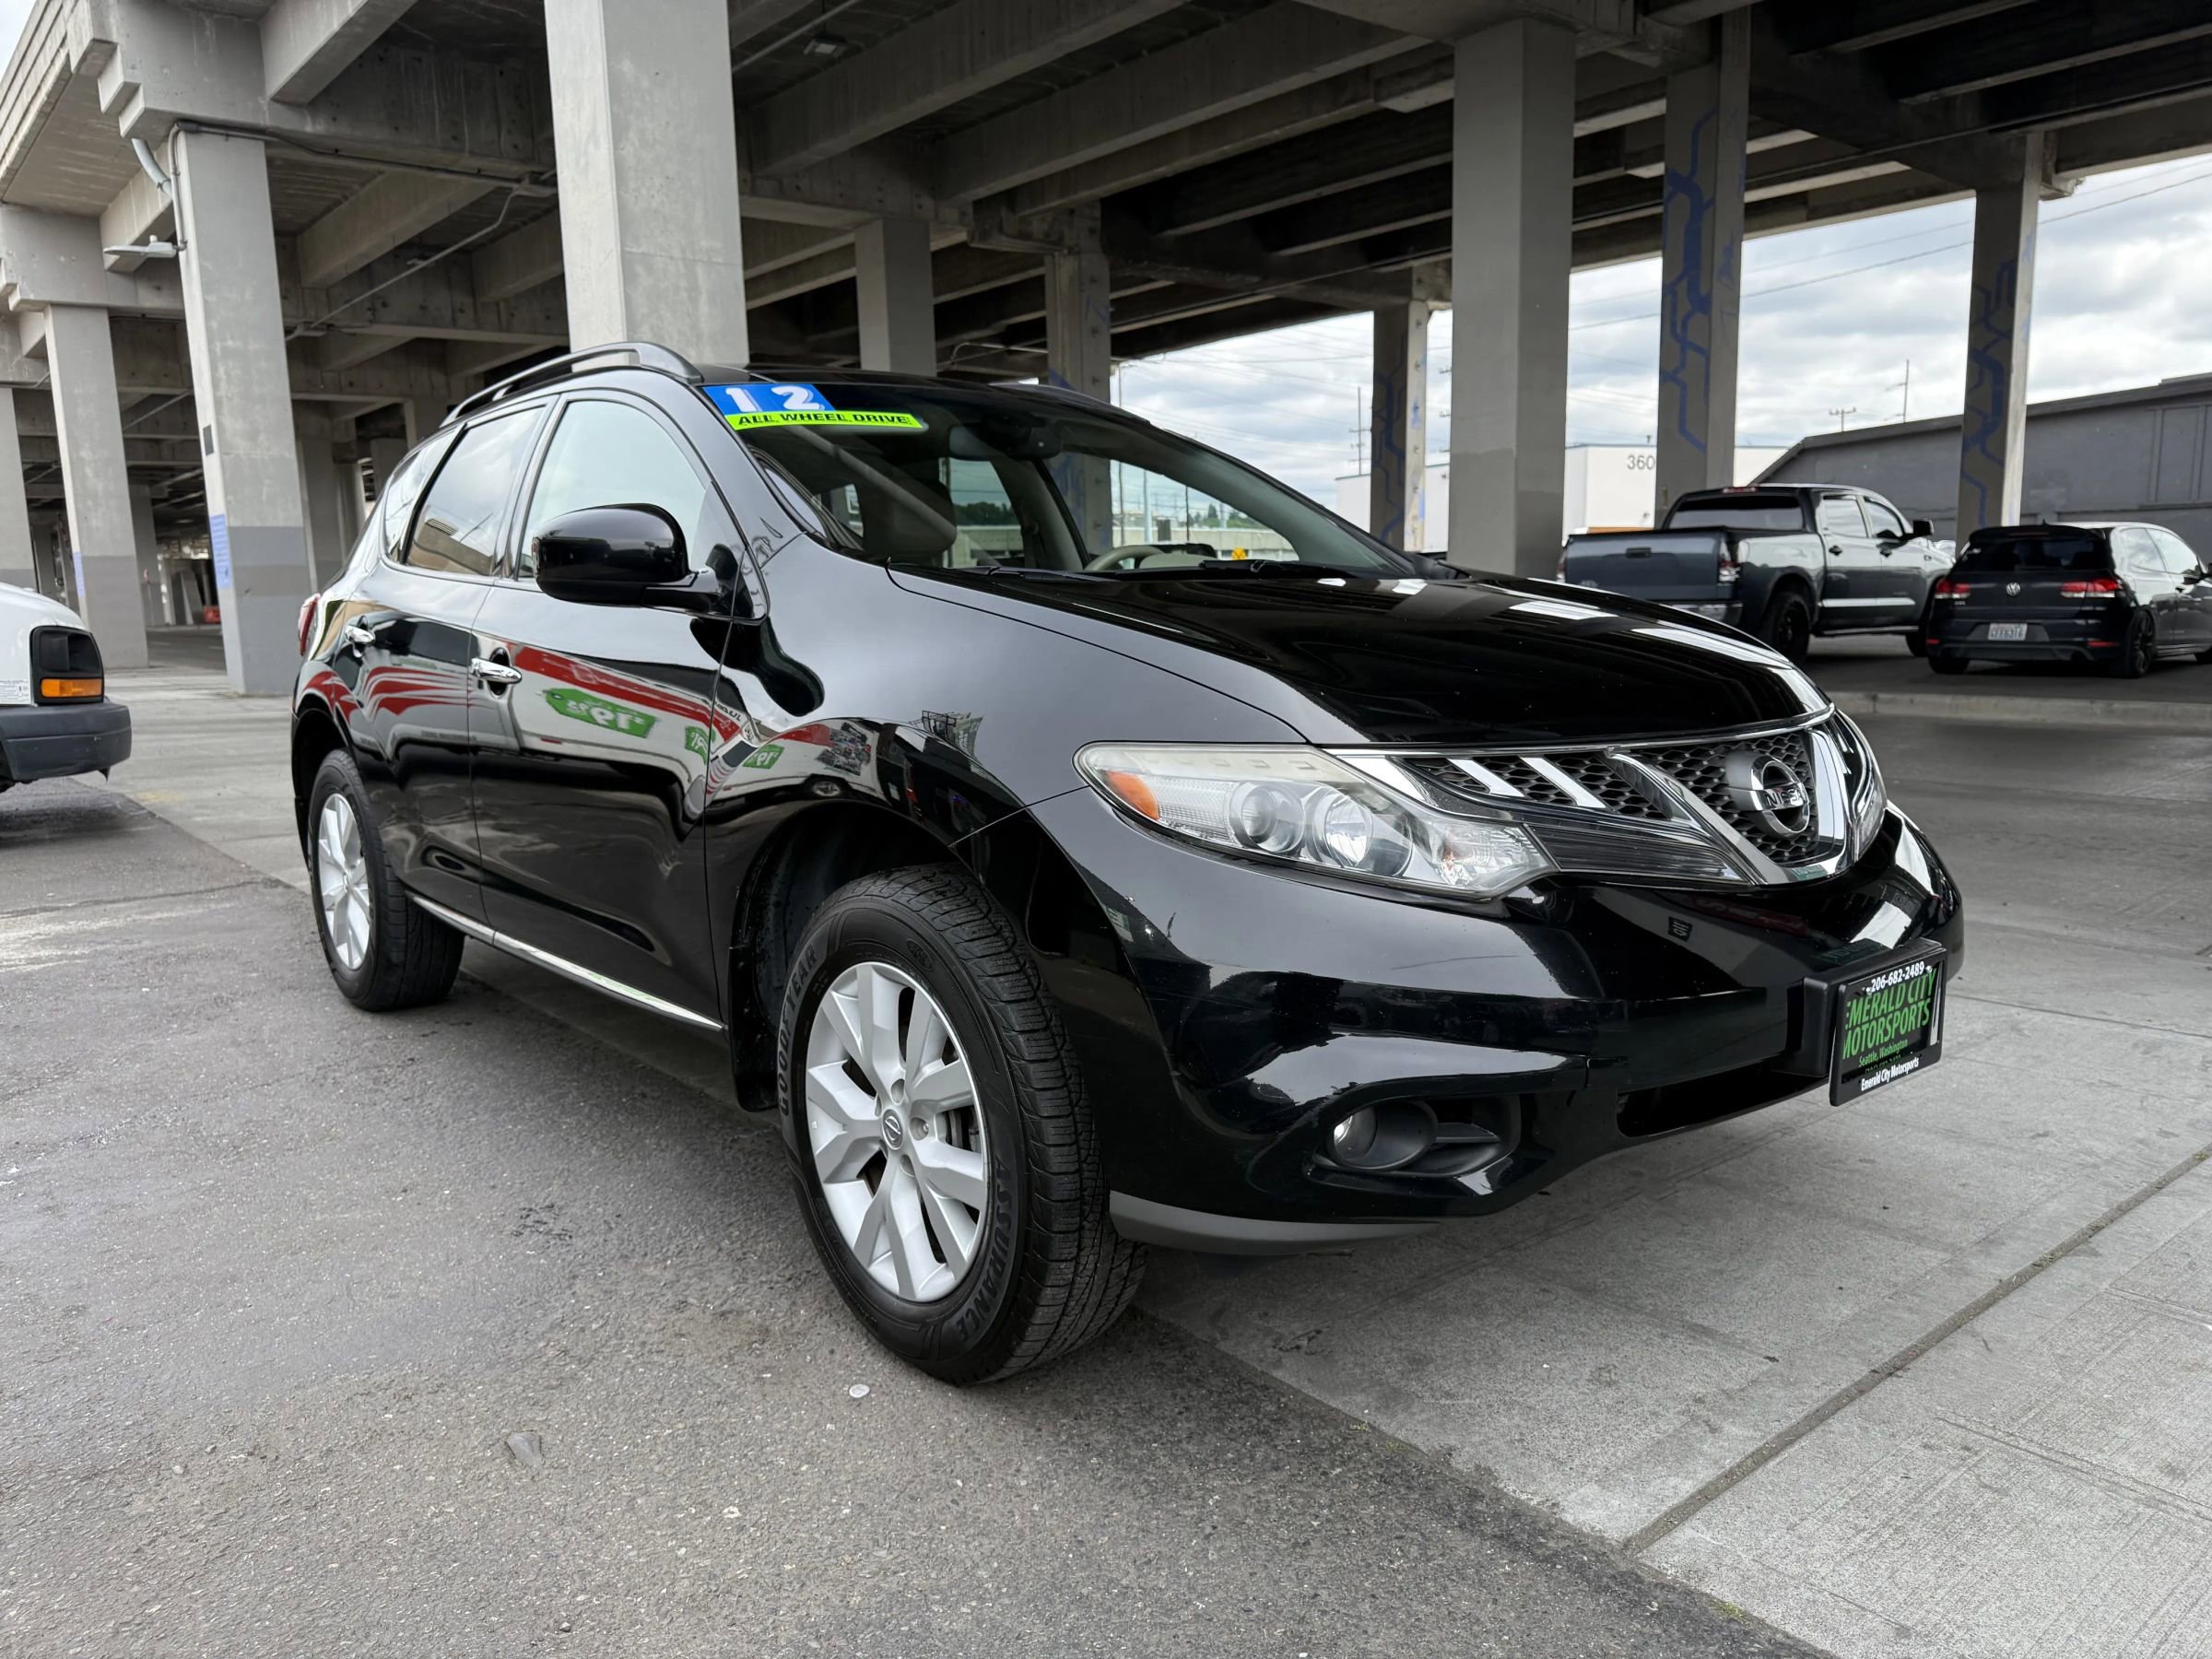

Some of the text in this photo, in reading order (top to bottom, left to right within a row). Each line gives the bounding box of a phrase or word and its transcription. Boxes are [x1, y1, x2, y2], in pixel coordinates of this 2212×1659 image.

[738, 412, 907, 426] ALL WHEEL DRIVE
[1627, 455, 1656, 470] 360
[1870, 961, 1925, 993] 206-682-2489
[1907, 969, 1936, 1004] CITY
[1879, 1040, 1908, 1058] Washington
[1861, 1070, 1882, 1091] Emerald
[1881, 1068, 1891, 1083] City
[1890, 1056, 1920, 1078] Motorsports
